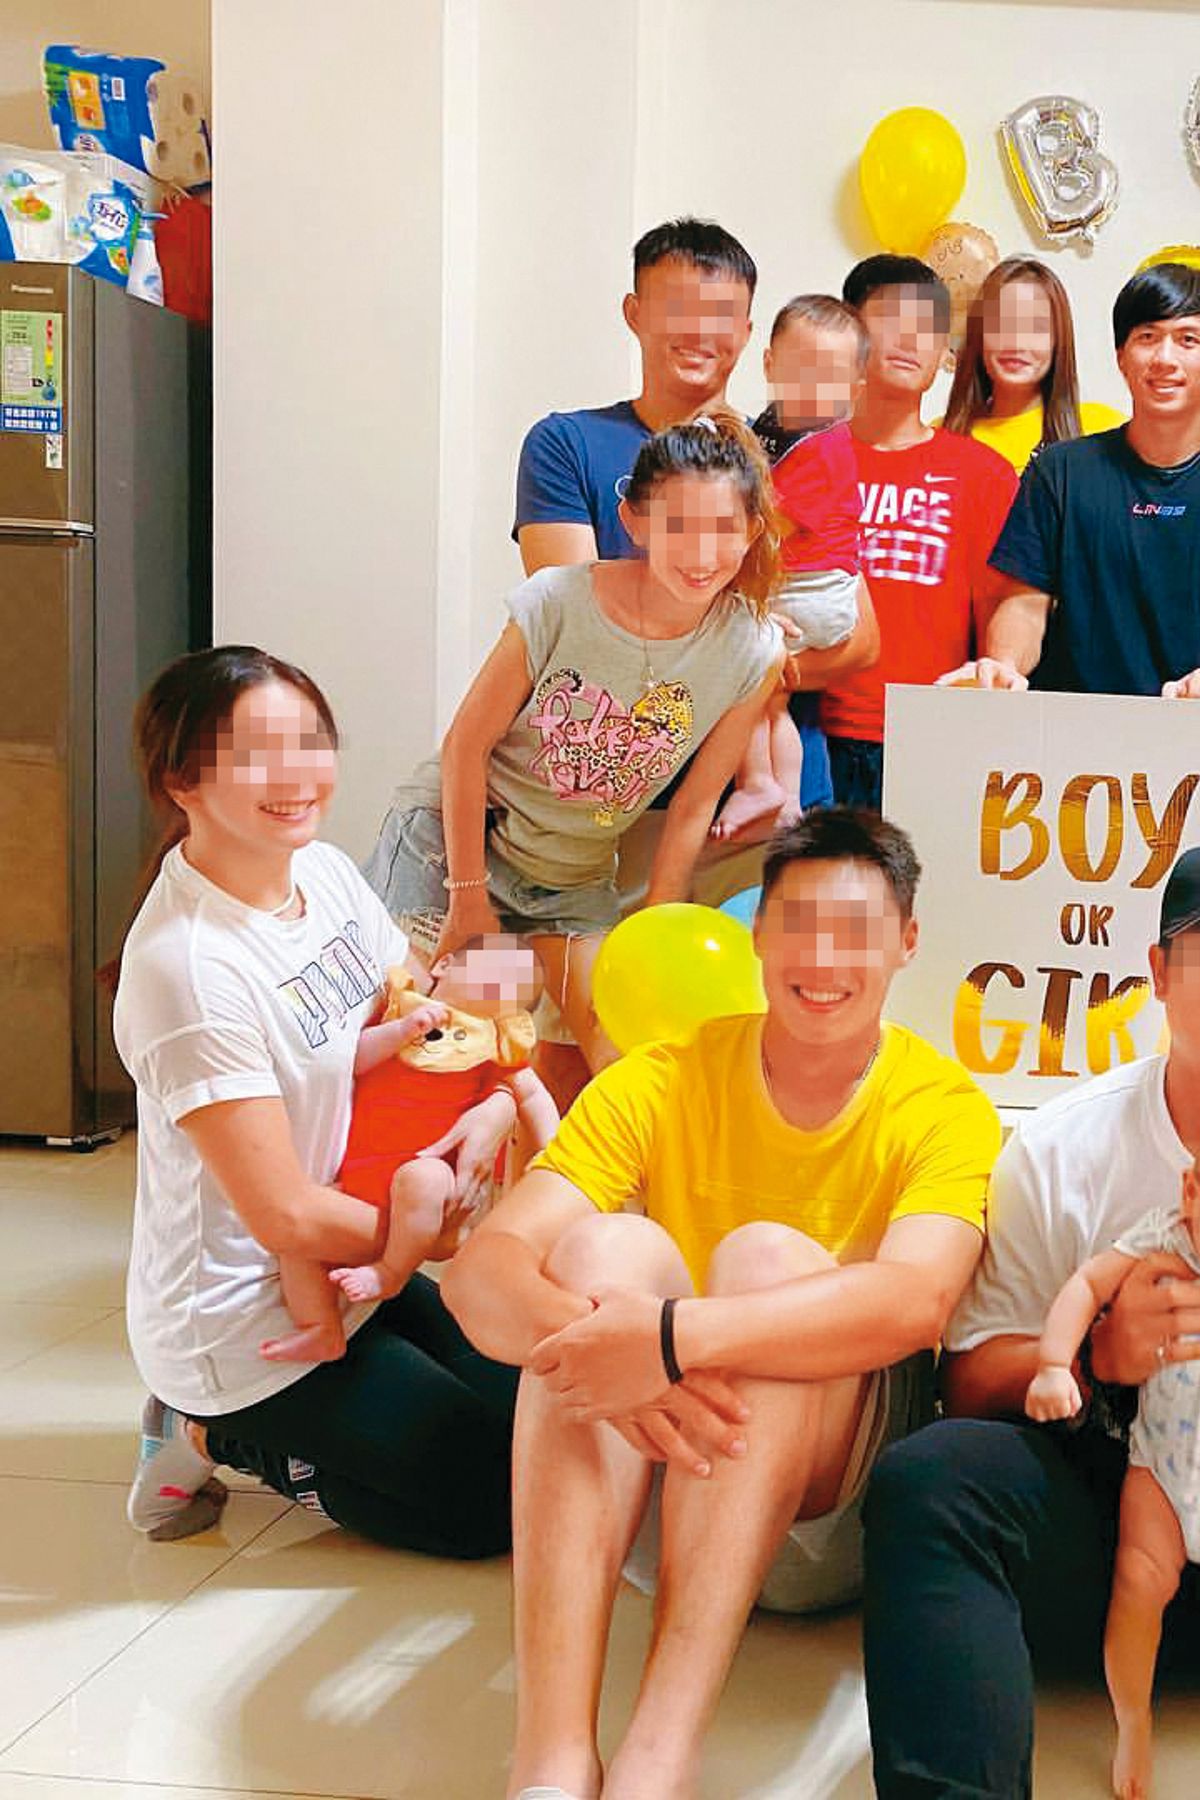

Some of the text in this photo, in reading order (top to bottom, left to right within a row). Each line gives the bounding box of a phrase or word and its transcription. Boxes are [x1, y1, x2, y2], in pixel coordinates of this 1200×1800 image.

[857, 528, 947, 586] EED
[979, 769, 1200, 889] BOY
[1060, 903, 1114, 947] OR
[952, 961, 1169, 1078] GIR
